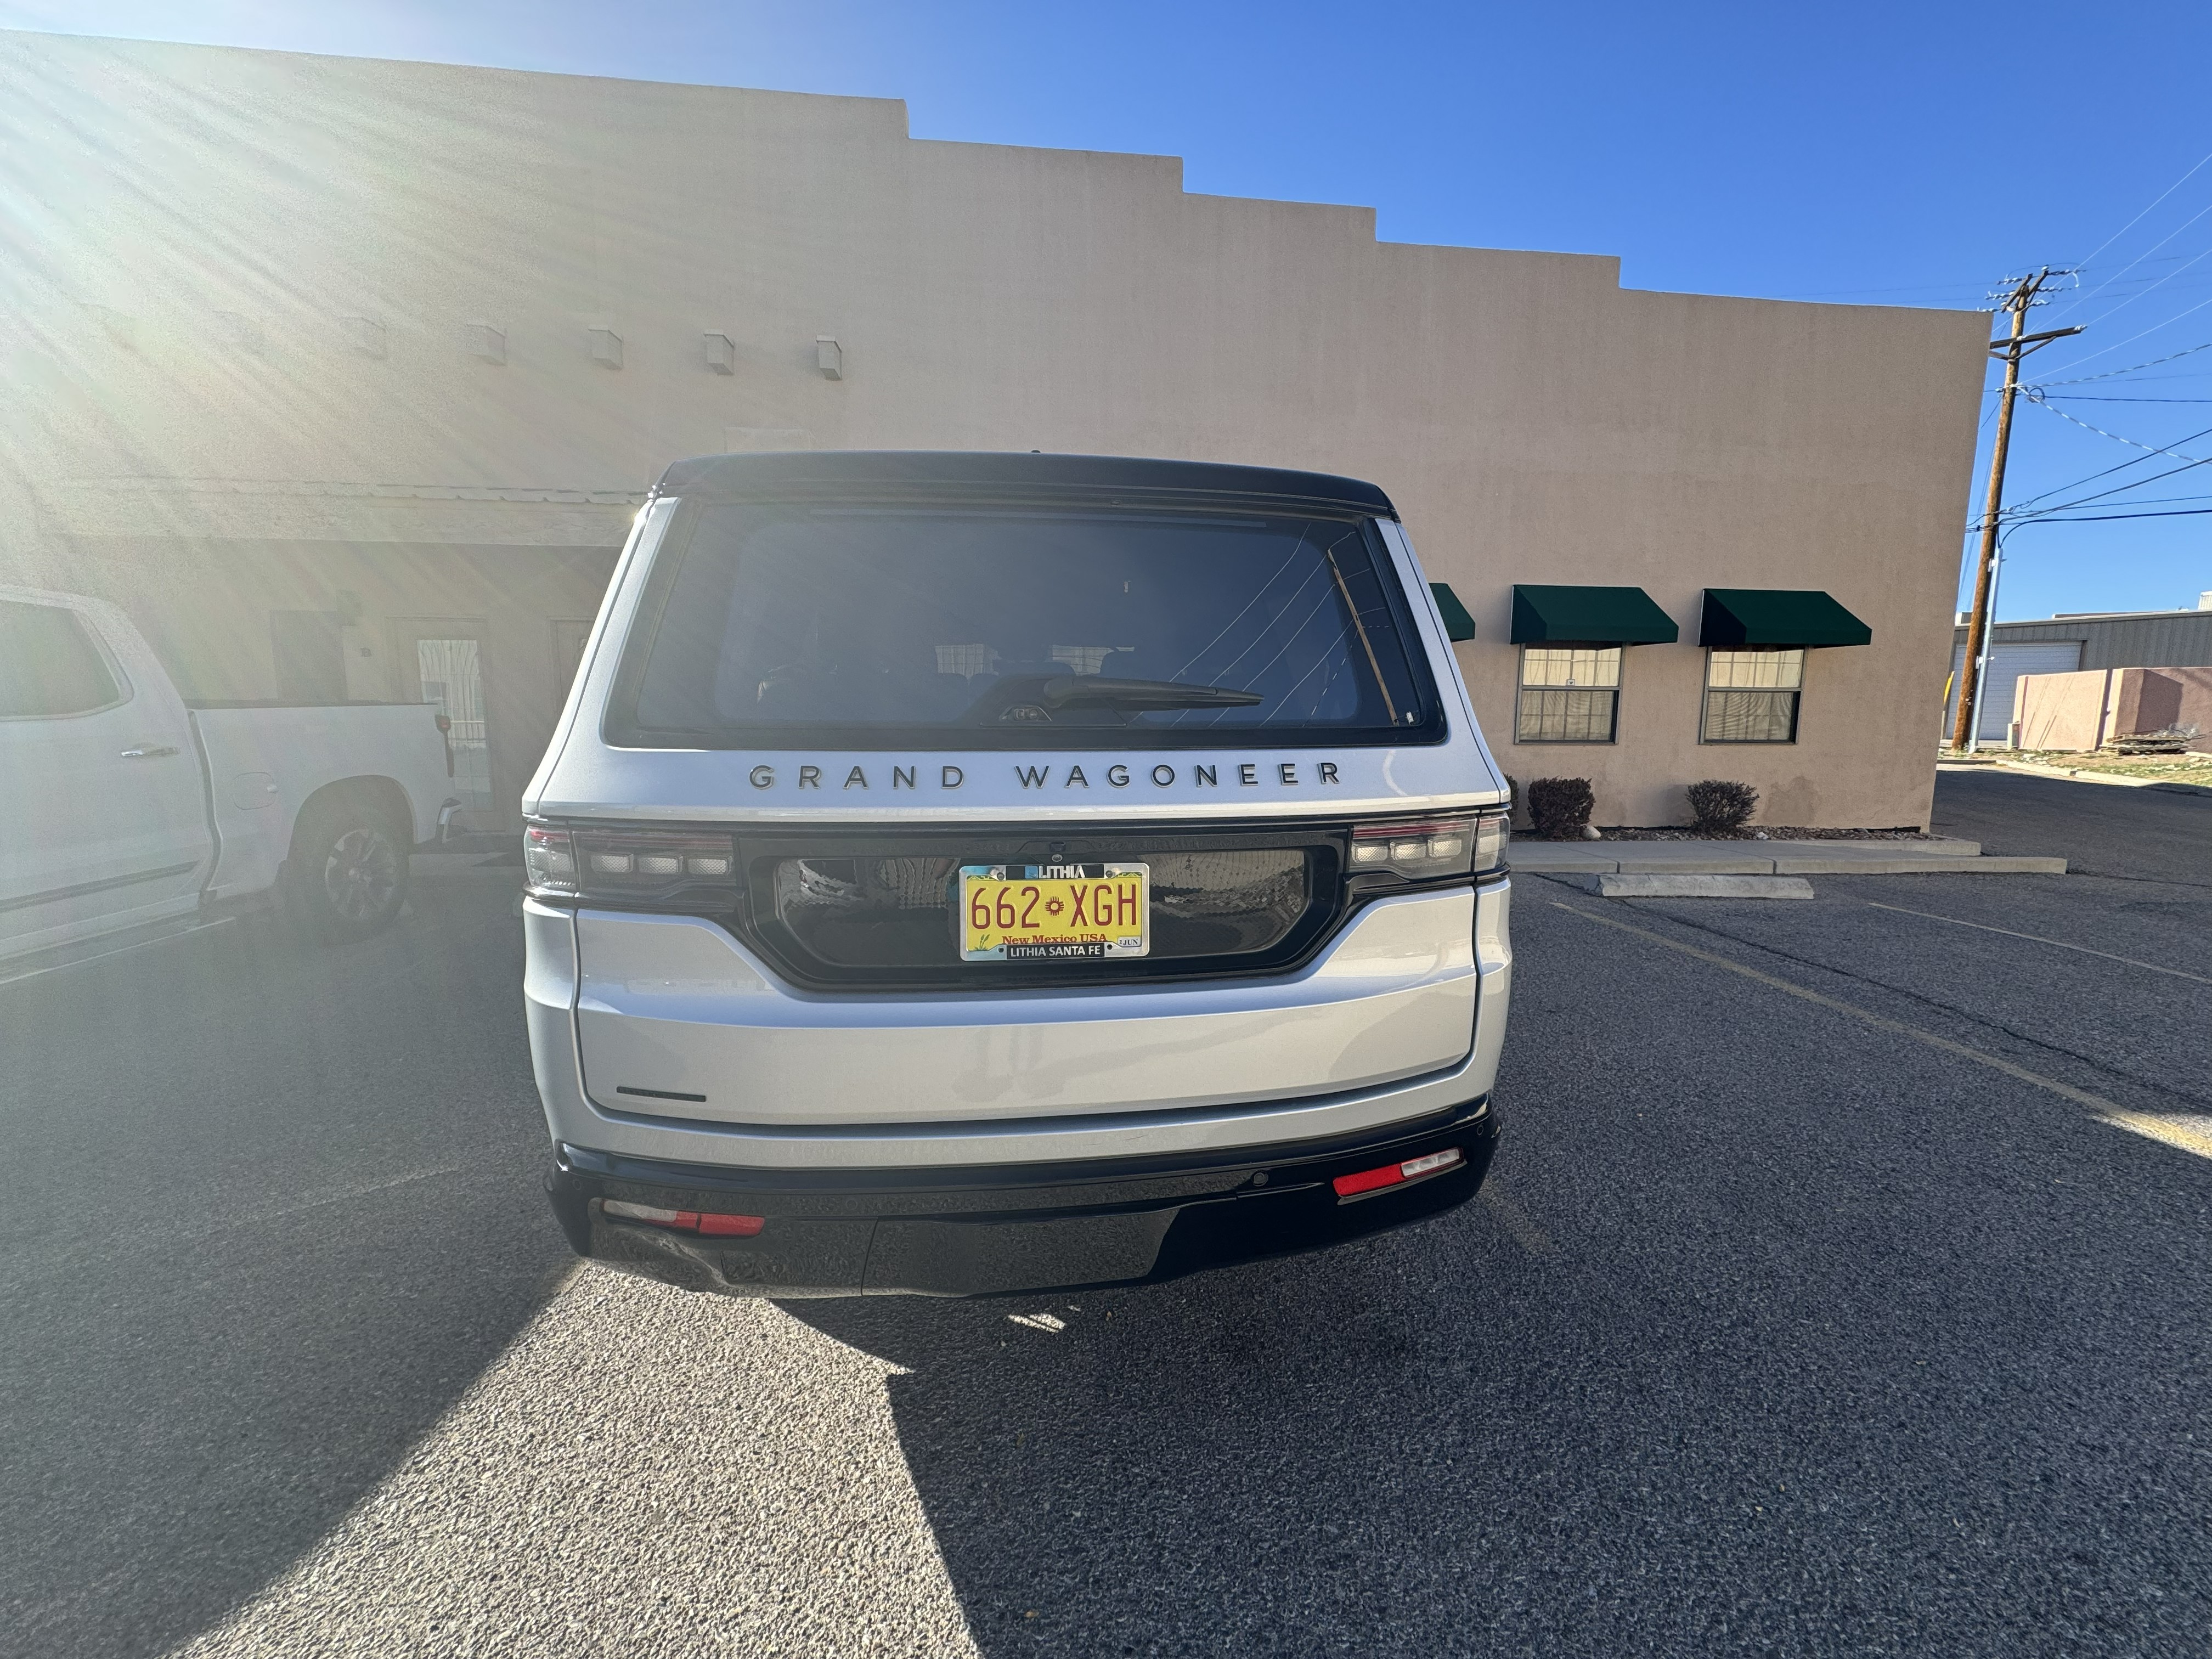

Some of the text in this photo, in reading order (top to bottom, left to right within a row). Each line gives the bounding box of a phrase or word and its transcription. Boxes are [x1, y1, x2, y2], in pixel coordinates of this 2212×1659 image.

[749, 762, 1340, 790] GRAND WAGONEER
[1039, 865, 1085, 878] LITHIA
[972, 884, 1137, 929] 662 XGH
[1002, 933, 1108, 944] New Mexico USA
[1011, 945, 1101, 957] LITHIA SANTA FE
